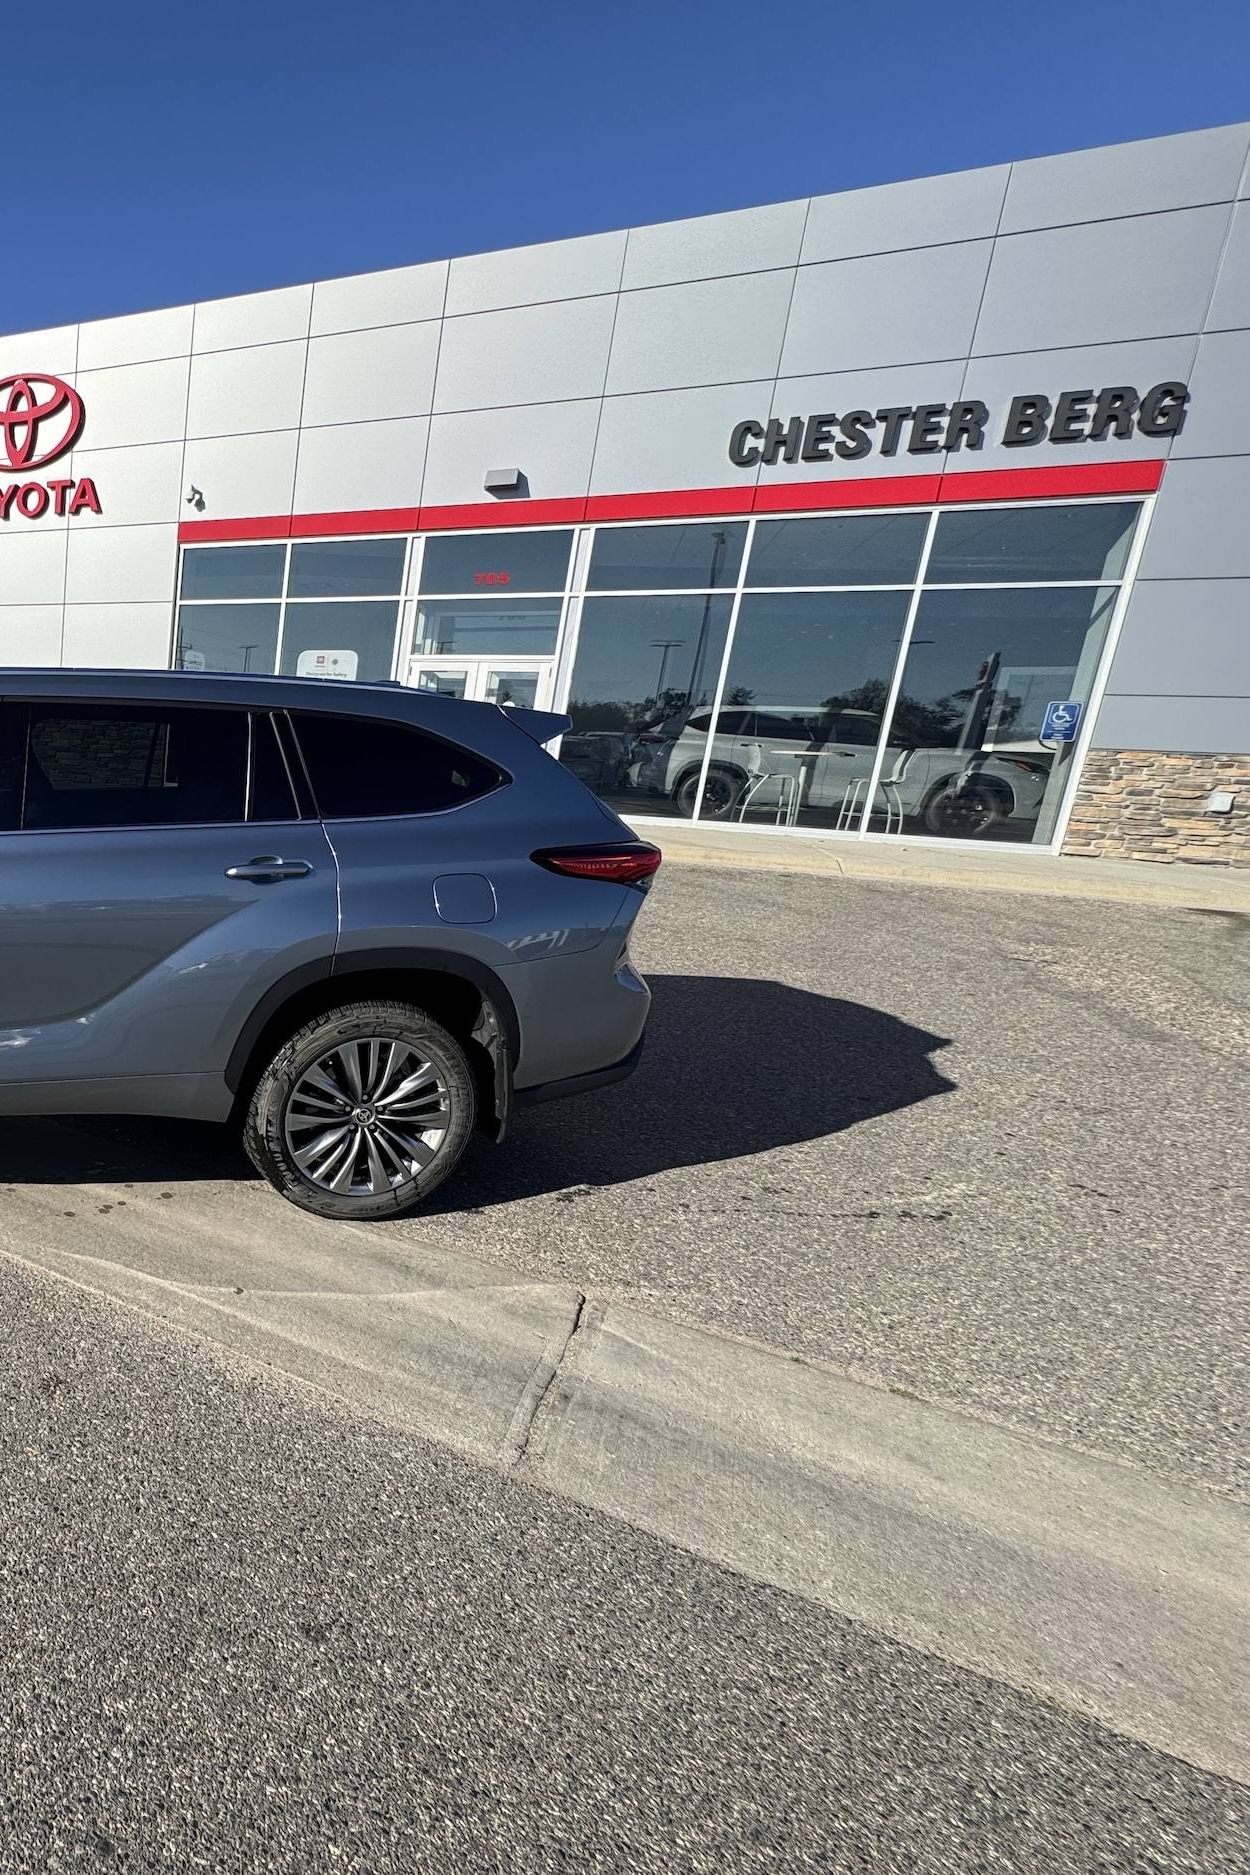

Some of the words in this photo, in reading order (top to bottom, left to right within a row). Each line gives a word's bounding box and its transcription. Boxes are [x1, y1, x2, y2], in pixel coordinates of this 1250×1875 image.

[728, 400, 989, 469] CHESTER
[1001, 381, 1190, 449] BERG
[474, 571, 510, 586] 705
